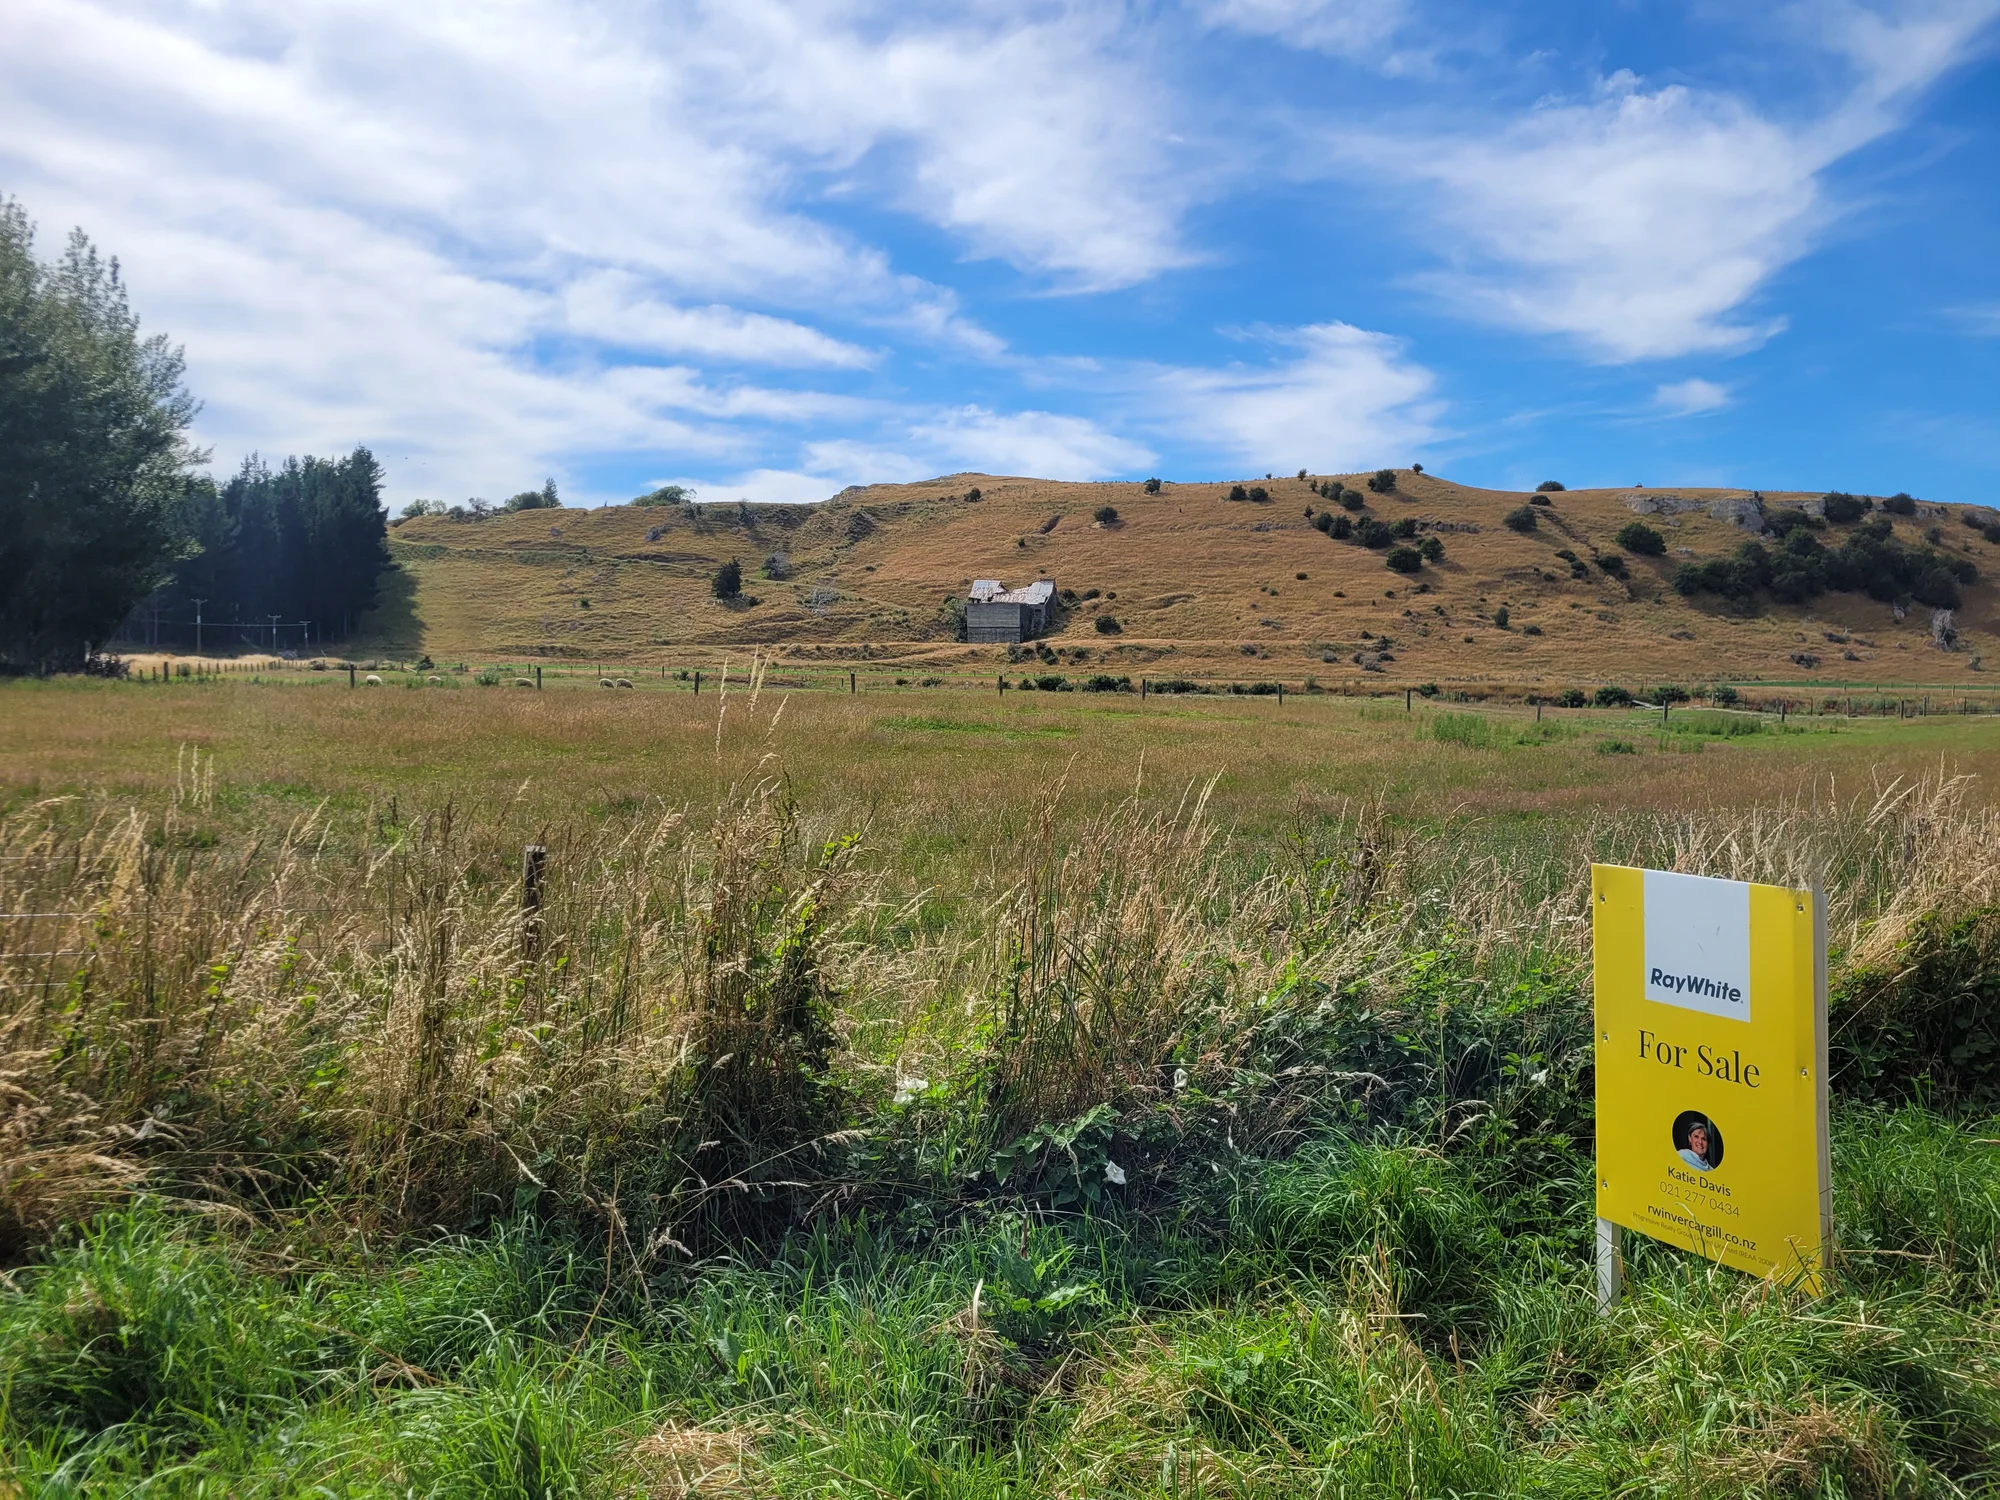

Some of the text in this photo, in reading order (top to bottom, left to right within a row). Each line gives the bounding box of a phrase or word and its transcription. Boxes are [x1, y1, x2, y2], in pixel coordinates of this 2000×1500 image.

[1638, 1029, 1761, 1088] For Sale
[1660, 1181, 1741, 1218] 021 277 0434
[1667, 1165, 1731, 1197] Katie Davis
[1647, 1204, 1757, 1251] rwinvercargill.co.nz
